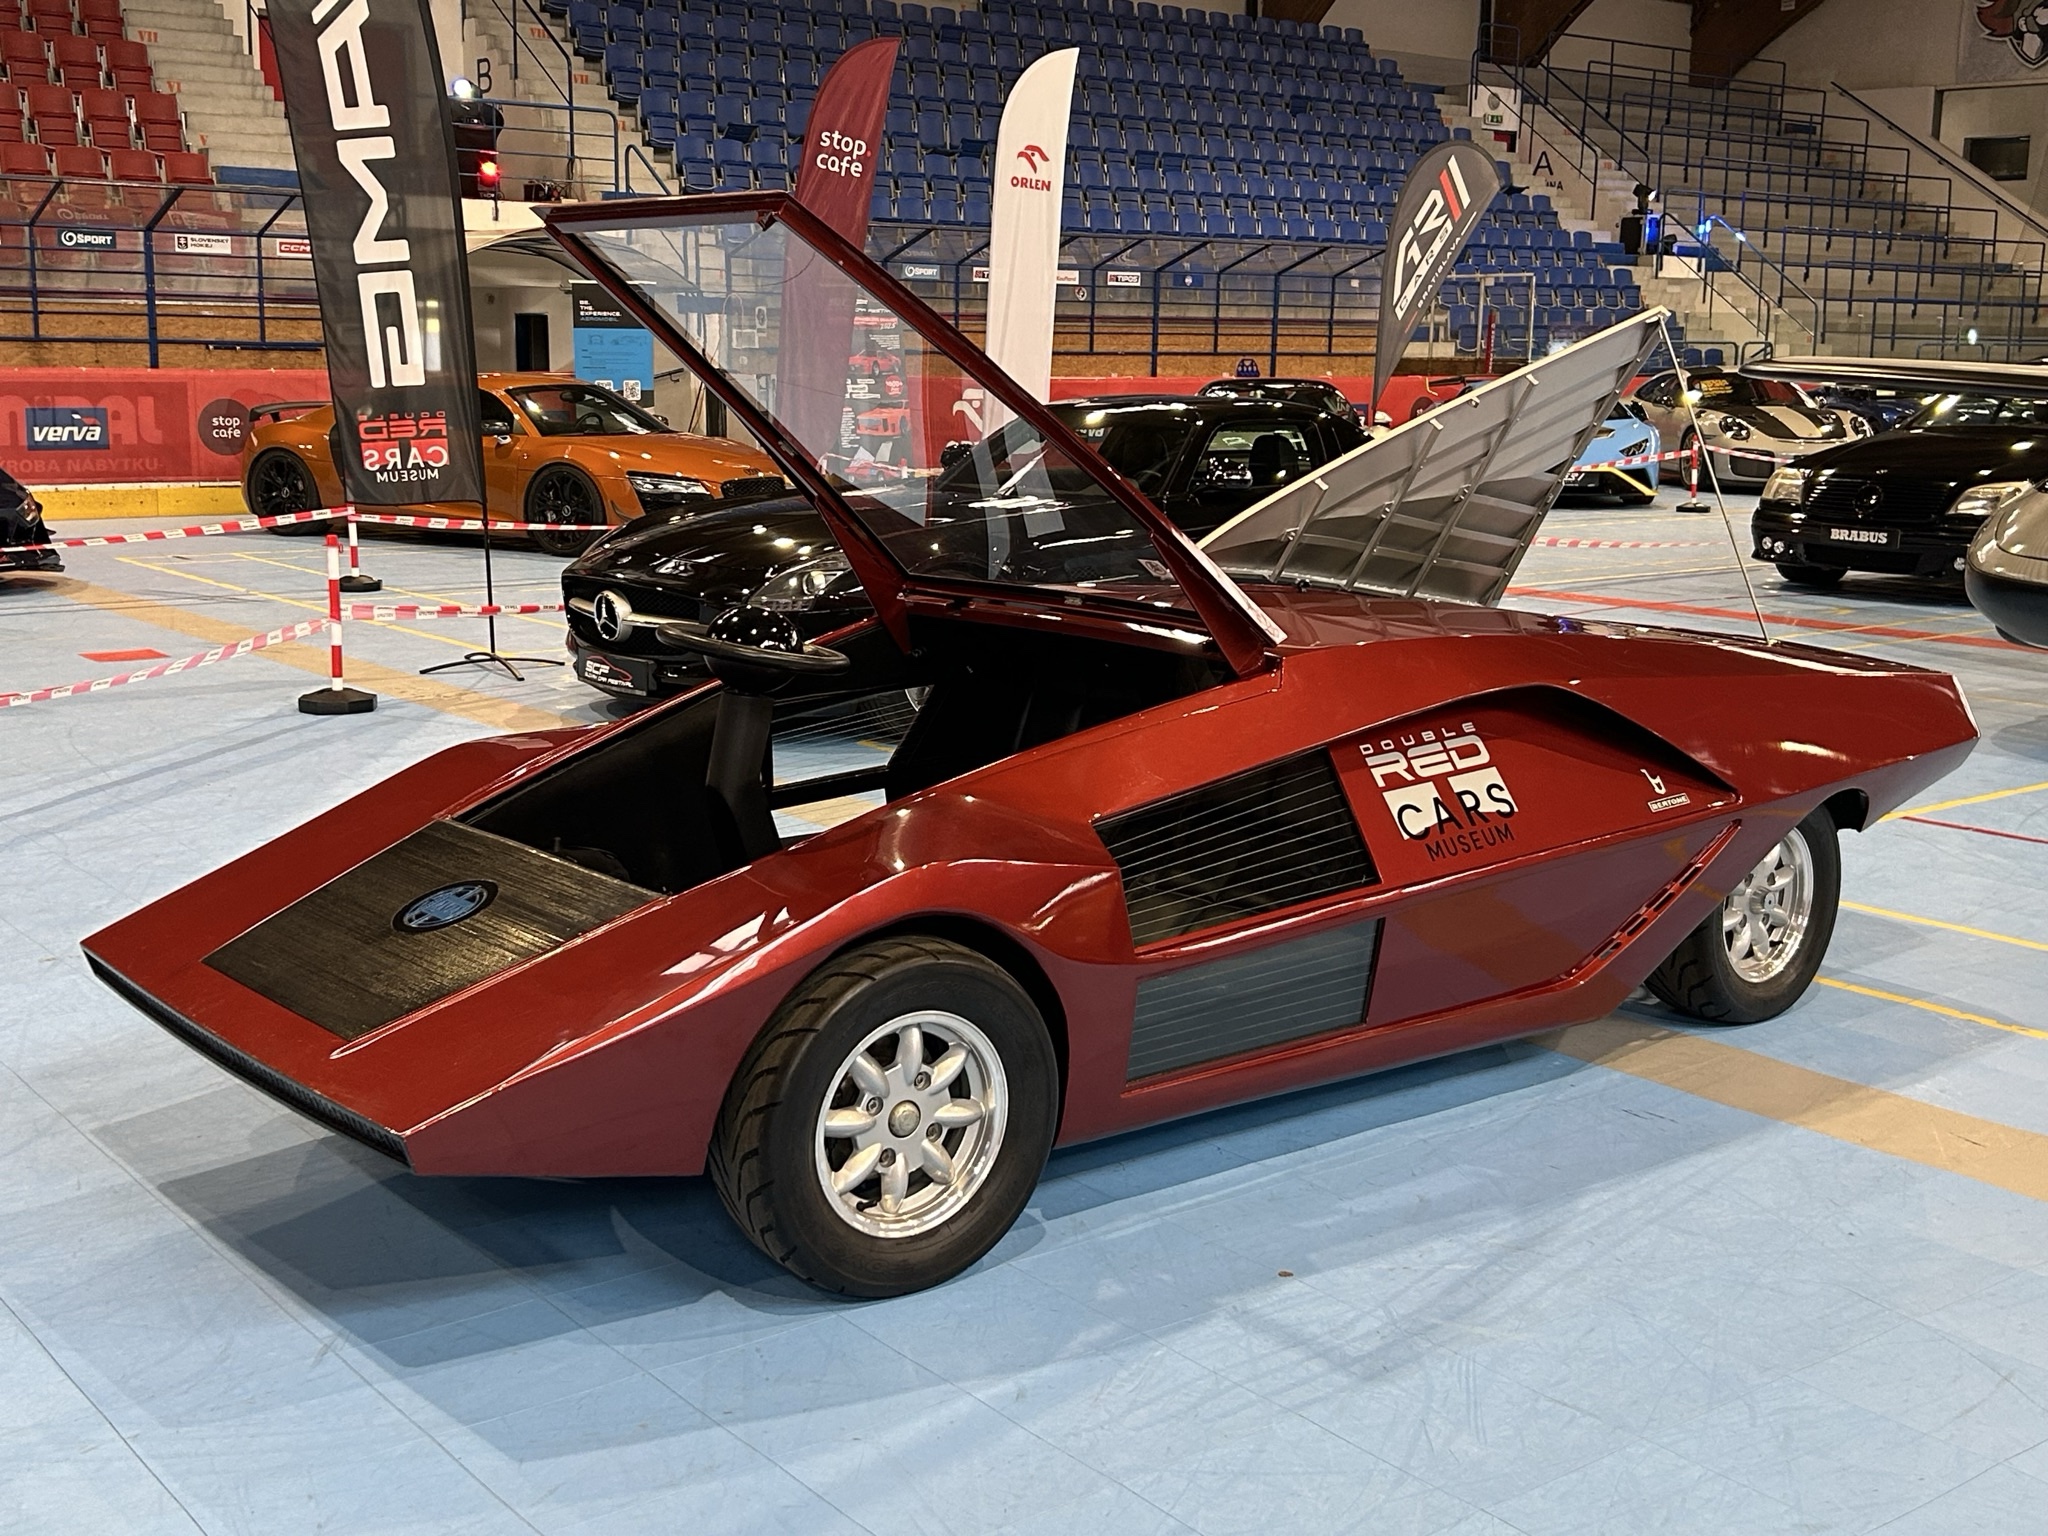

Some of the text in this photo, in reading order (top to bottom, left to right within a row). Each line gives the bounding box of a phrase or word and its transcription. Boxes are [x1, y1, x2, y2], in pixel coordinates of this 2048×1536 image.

[476, 57, 493, 94] B
[816, 152, 863, 178] cafe
[1532, 151, 1554, 177] A
[1010, 175, 1052, 192] ORLEN
[1117, 274, 1139, 283] TIPOS
[1399, 226, 1449, 312] CARS
[1417, 236, 1462, 309] BRATISLAVA
[33, 426, 102, 442] verva
[212, 427, 242, 439] cafe
[1830, 527, 1888, 545] BRABUS
[1358, 721, 1477, 756] DOUBLE
[1364, 733, 1491, 788] RED
[1396, 782, 1516, 841] CARS
[1651, 795, 1688, 811] BERTONE
[1425, 822, 1516, 862] MUSEUM
